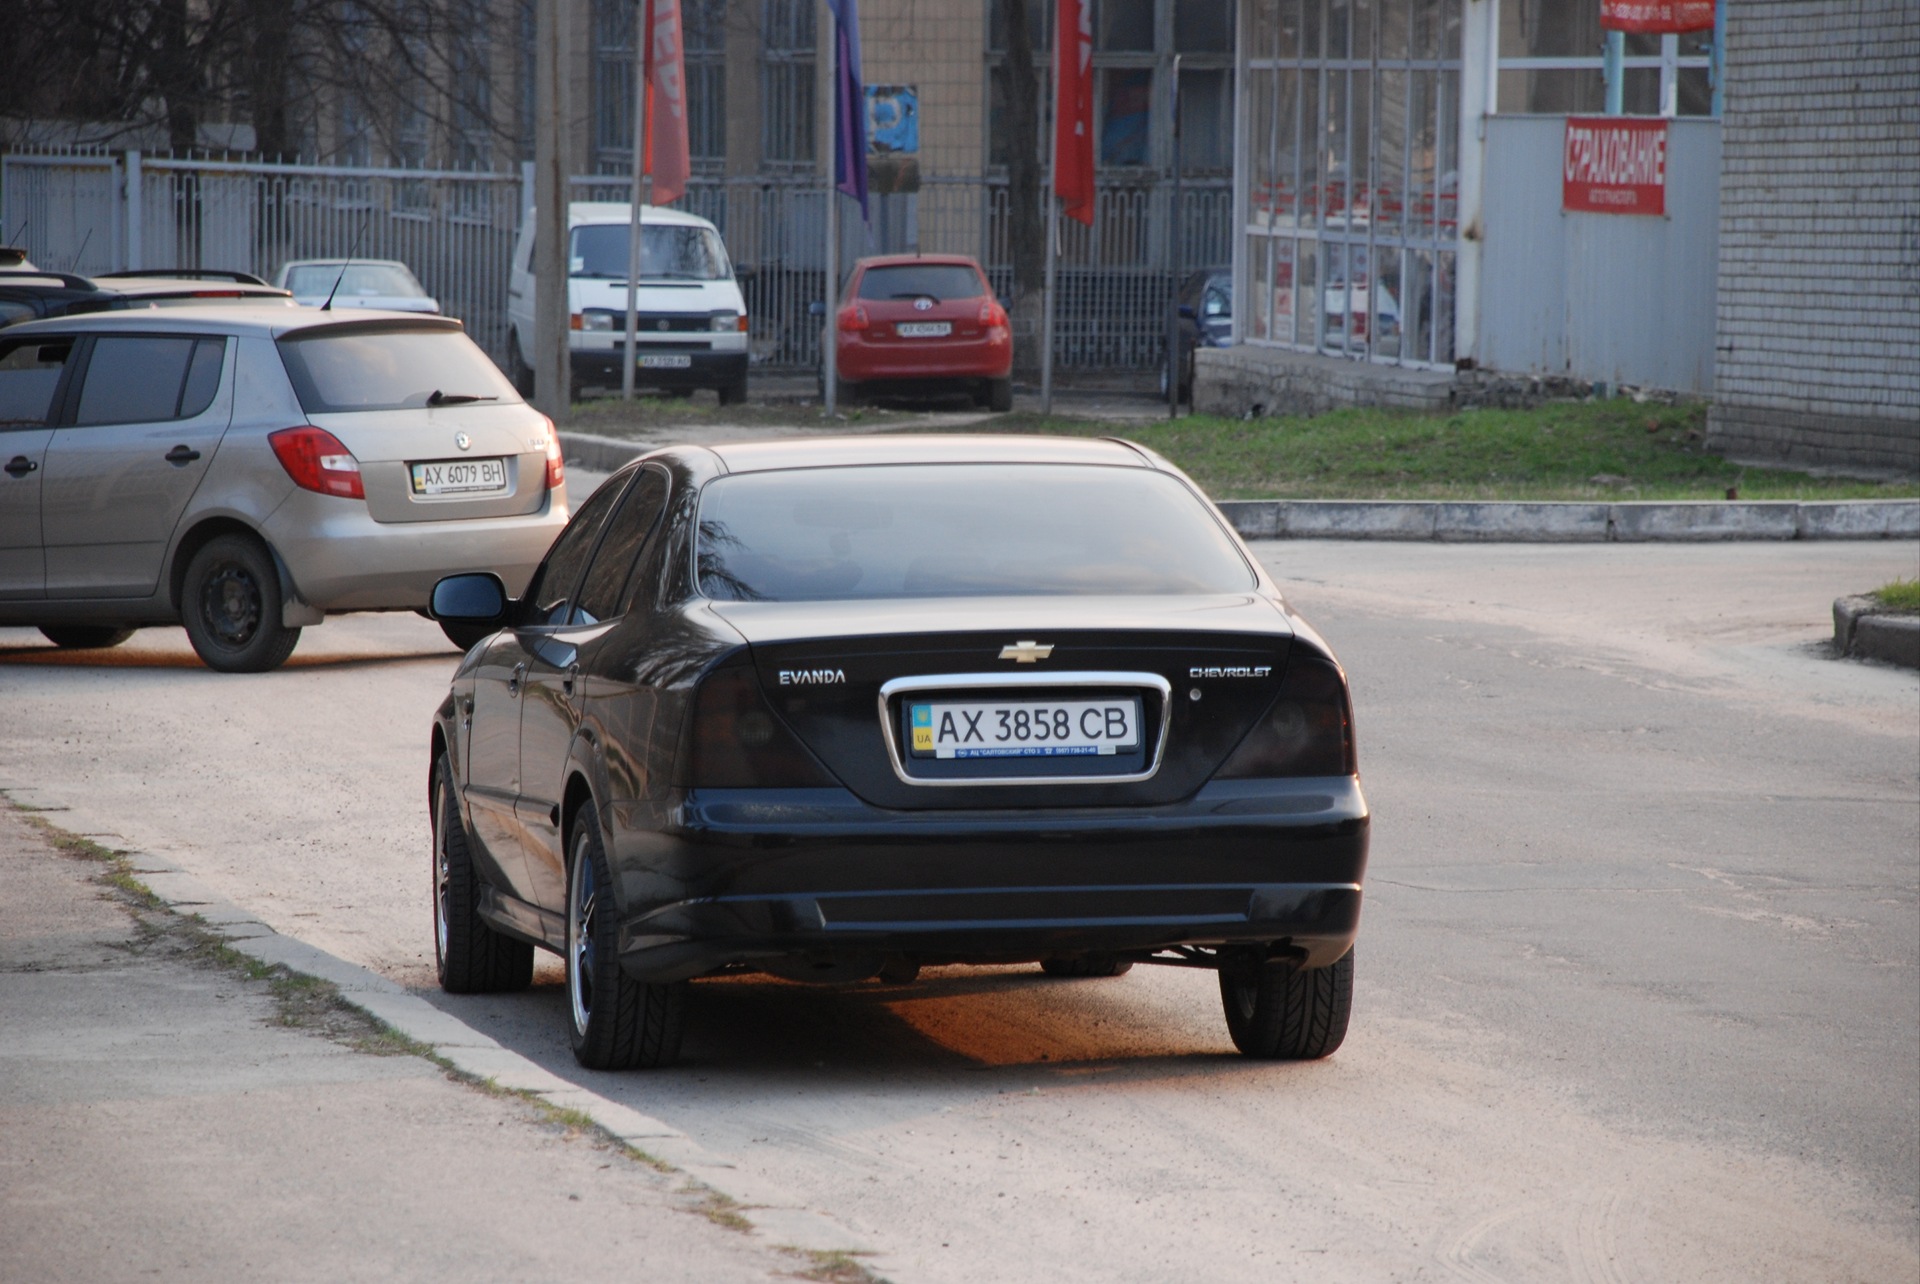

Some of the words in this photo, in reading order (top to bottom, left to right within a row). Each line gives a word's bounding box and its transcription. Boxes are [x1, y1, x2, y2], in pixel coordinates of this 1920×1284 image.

[1565, 127, 1666, 185] СТРАХОВАНИЕ
[425, 466, 444, 485] AX
[449, 465, 477, 482] 6079
[483, 463, 502, 482] BH
[779, 669, 846, 685] EVANDA
[1189, 665, 1272, 678] CHEVROLET
[938, 710, 985, 743] AX
[995, 709, 1071, 742] 3858
[1080, 707, 1128, 739] CB
[917, 734, 931, 744] UA
